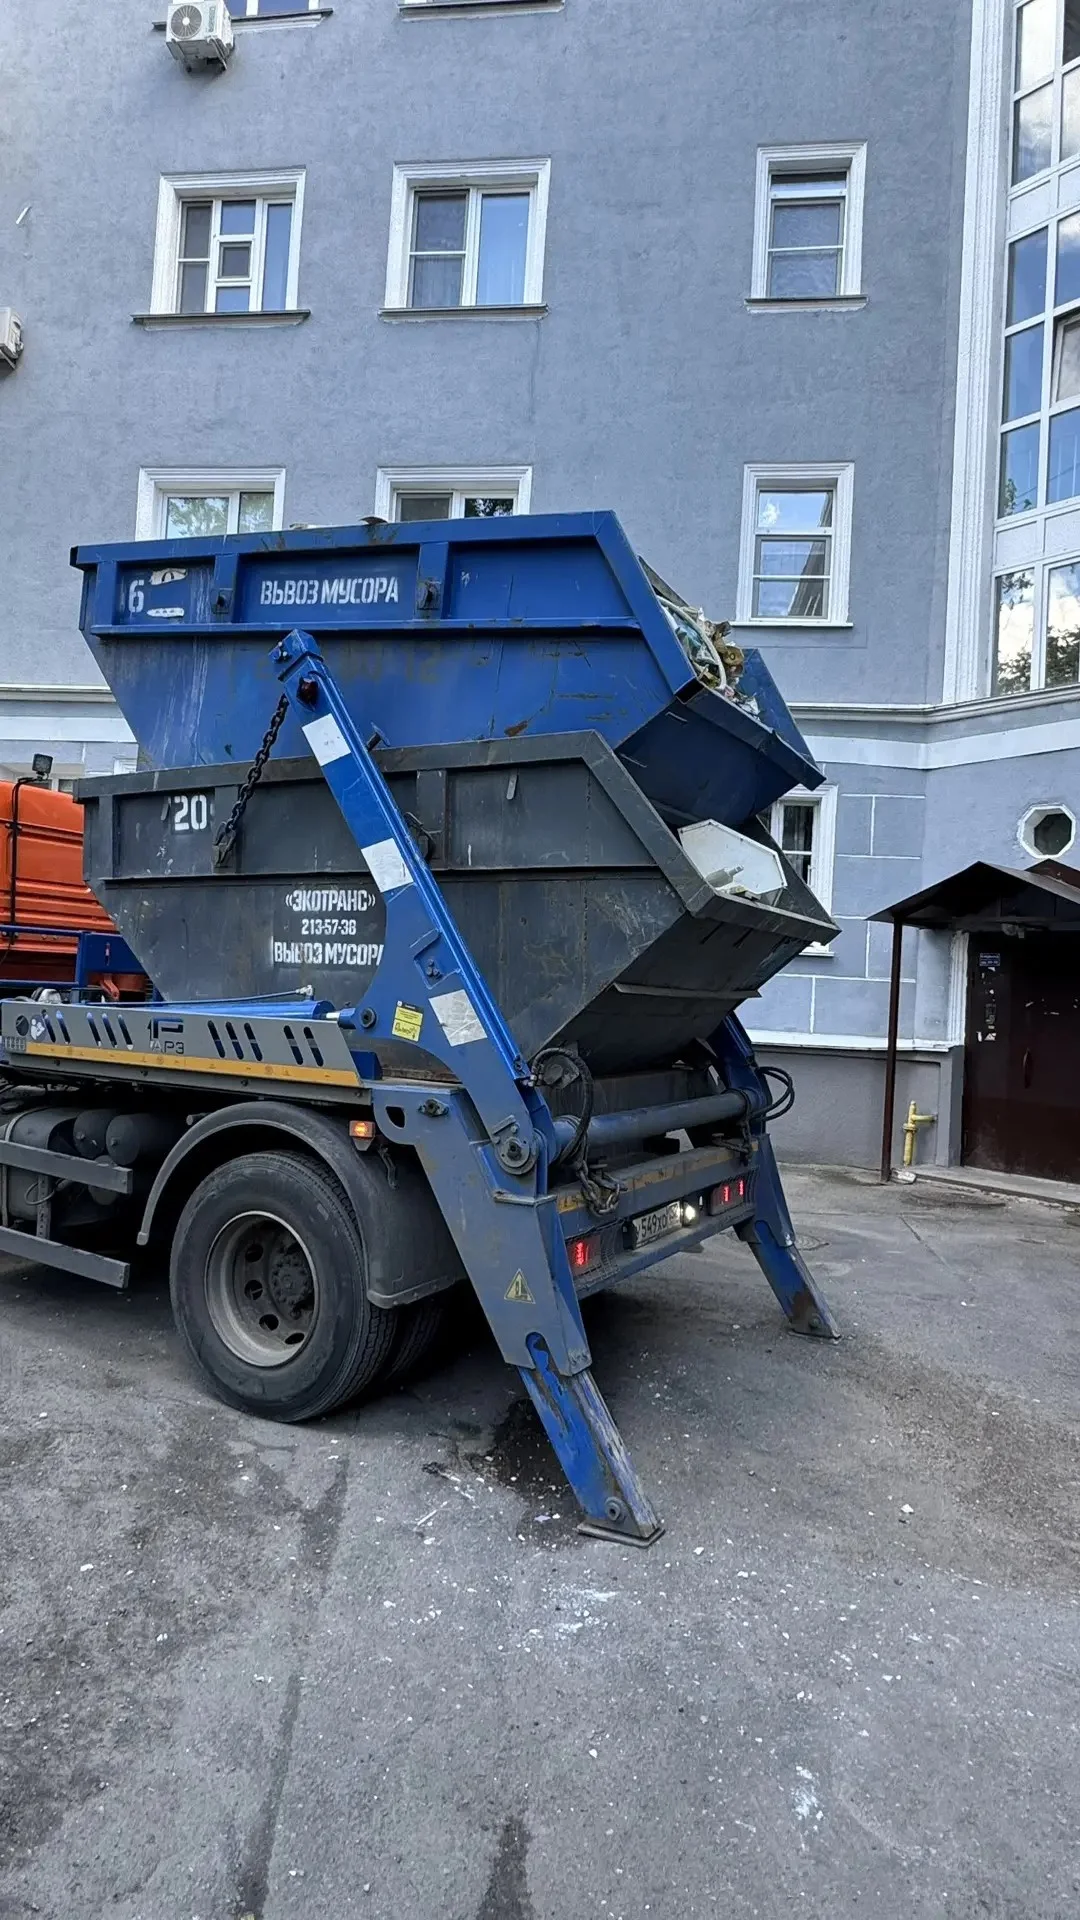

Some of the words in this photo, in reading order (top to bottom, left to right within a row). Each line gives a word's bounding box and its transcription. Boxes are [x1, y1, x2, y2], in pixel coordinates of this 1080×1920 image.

[128, 580, 144, 613] 6
[321, 576, 399, 604] МУСОРА
[174, 794, 207, 831] 20
[301, 918, 357, 935] 213-57-38
[274, 941, 322, 964] ВЫВОЗ
